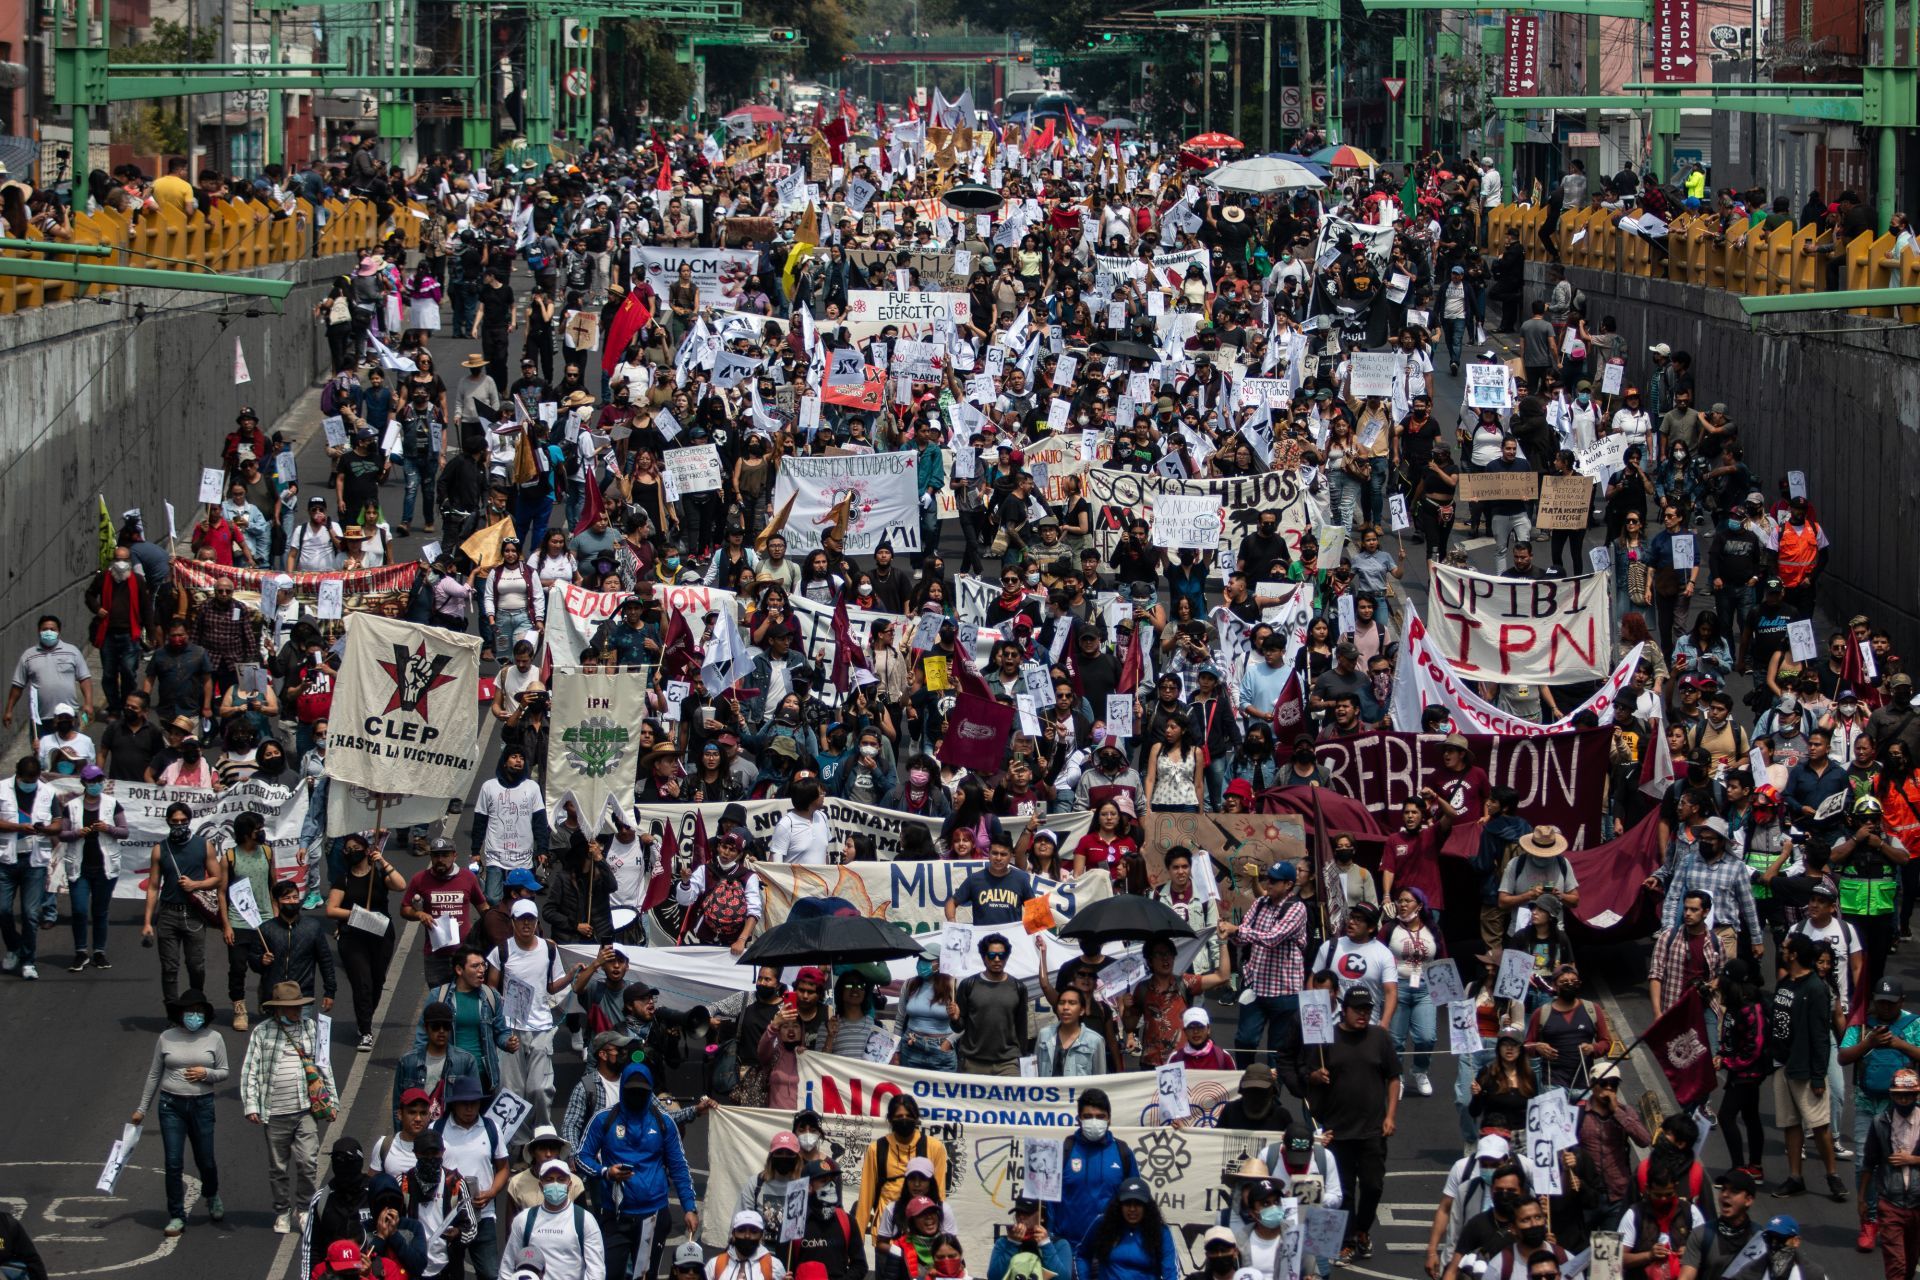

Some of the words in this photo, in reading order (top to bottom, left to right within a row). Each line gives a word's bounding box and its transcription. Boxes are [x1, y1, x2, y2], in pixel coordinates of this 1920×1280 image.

[1508, 19, 1520, 92] VERIFICENTRO
[1523, 21, 1535, 75] ENTRADA
[664, 258, 717, 273] UACM
[889, 292, 910, 305] FUE
[920, 293, 935, 303] EL
[878, 304, 945, 320] EJÉRCITO
[1243, 387, 1254, 395] NO
[1065, 441, 1073, 450] DE
[1607, 445, 1620, 455] 367
[790, 457, 845, 477] PERDONAMOS
[857, 455, 904, 475] OLVIDAMOS
[1028, 450, 1063, 466] MINUTO
[1090, 469, 1204, 506] SOMOS
[1209, 470, 1298, 509] HIJOS
[1156, 497, 1170, 516] YO
[1431, 566, 1595, 619] UPIBI
[1445, 613, 1596, 676] IPN
[587, 697, 610, 709] IPN
[364, 716, 440, 745] CLEP
[562, 727, 630, 743] ESIME
[329, 734, 381, 757] ¡HASTA
[404, 747, 474, 771] VICTORIA!
[1315, 735, 1580, 812] REBEION
[129, 787, 150, 799] POR
[153, 788, 168, 801] LA
[144, 806, 152, 818] Y
[154, 806, 167, 818] EL
[221, 802, 229, 814] A
[231, 800, 245, 813] LA
[249, 800, 281, 817] CIUDAD
[753, 811, 783, 831] NO
[435, 894, 459, 902] DDP
[979, 888, 1018, 908] CALVIN
[913, 1080, 1061, 1103] OLVIDAMOS
[801, 1238, 828, 1248] Calvin
